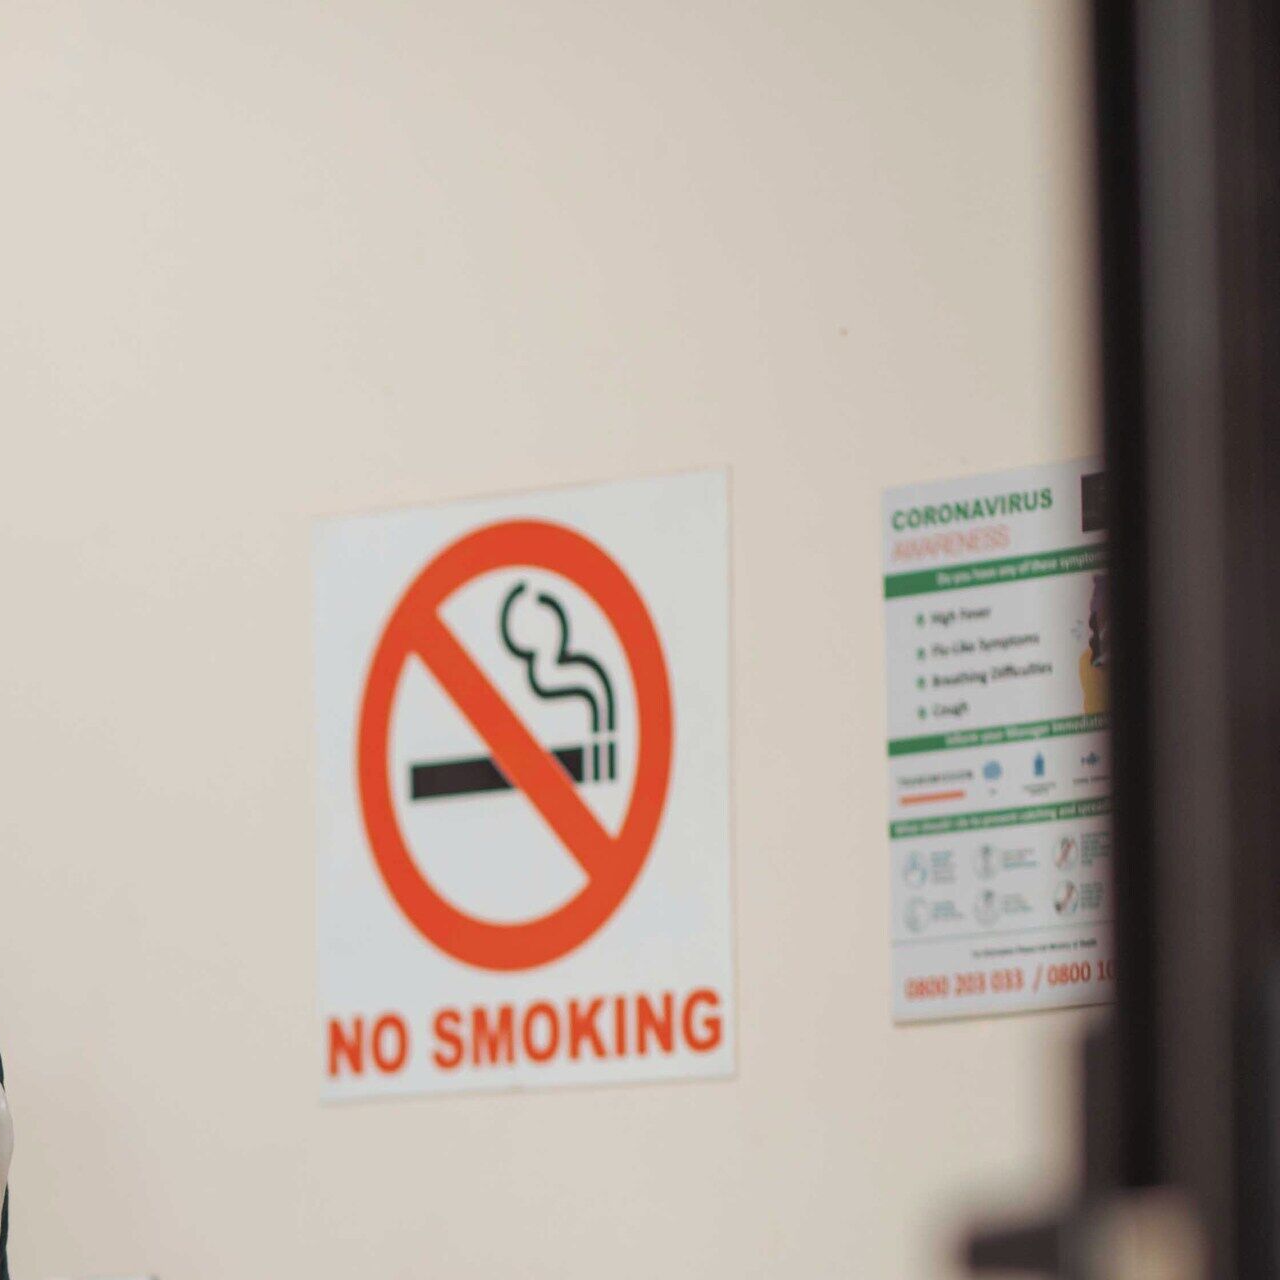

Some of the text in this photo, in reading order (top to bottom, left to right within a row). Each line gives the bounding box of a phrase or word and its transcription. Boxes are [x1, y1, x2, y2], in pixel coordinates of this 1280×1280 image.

[892, 488, 1053, 529] CORONAVIRUS
[979, 632, 1040, 650] Symptoms
[933, 662, 1052, 686] Breathing Difficulties
[932, 701, 968, 717] Cough
[1047, 960, 1090, 987] 0800
[327, 986, 723, 1077] NO SMOKING
